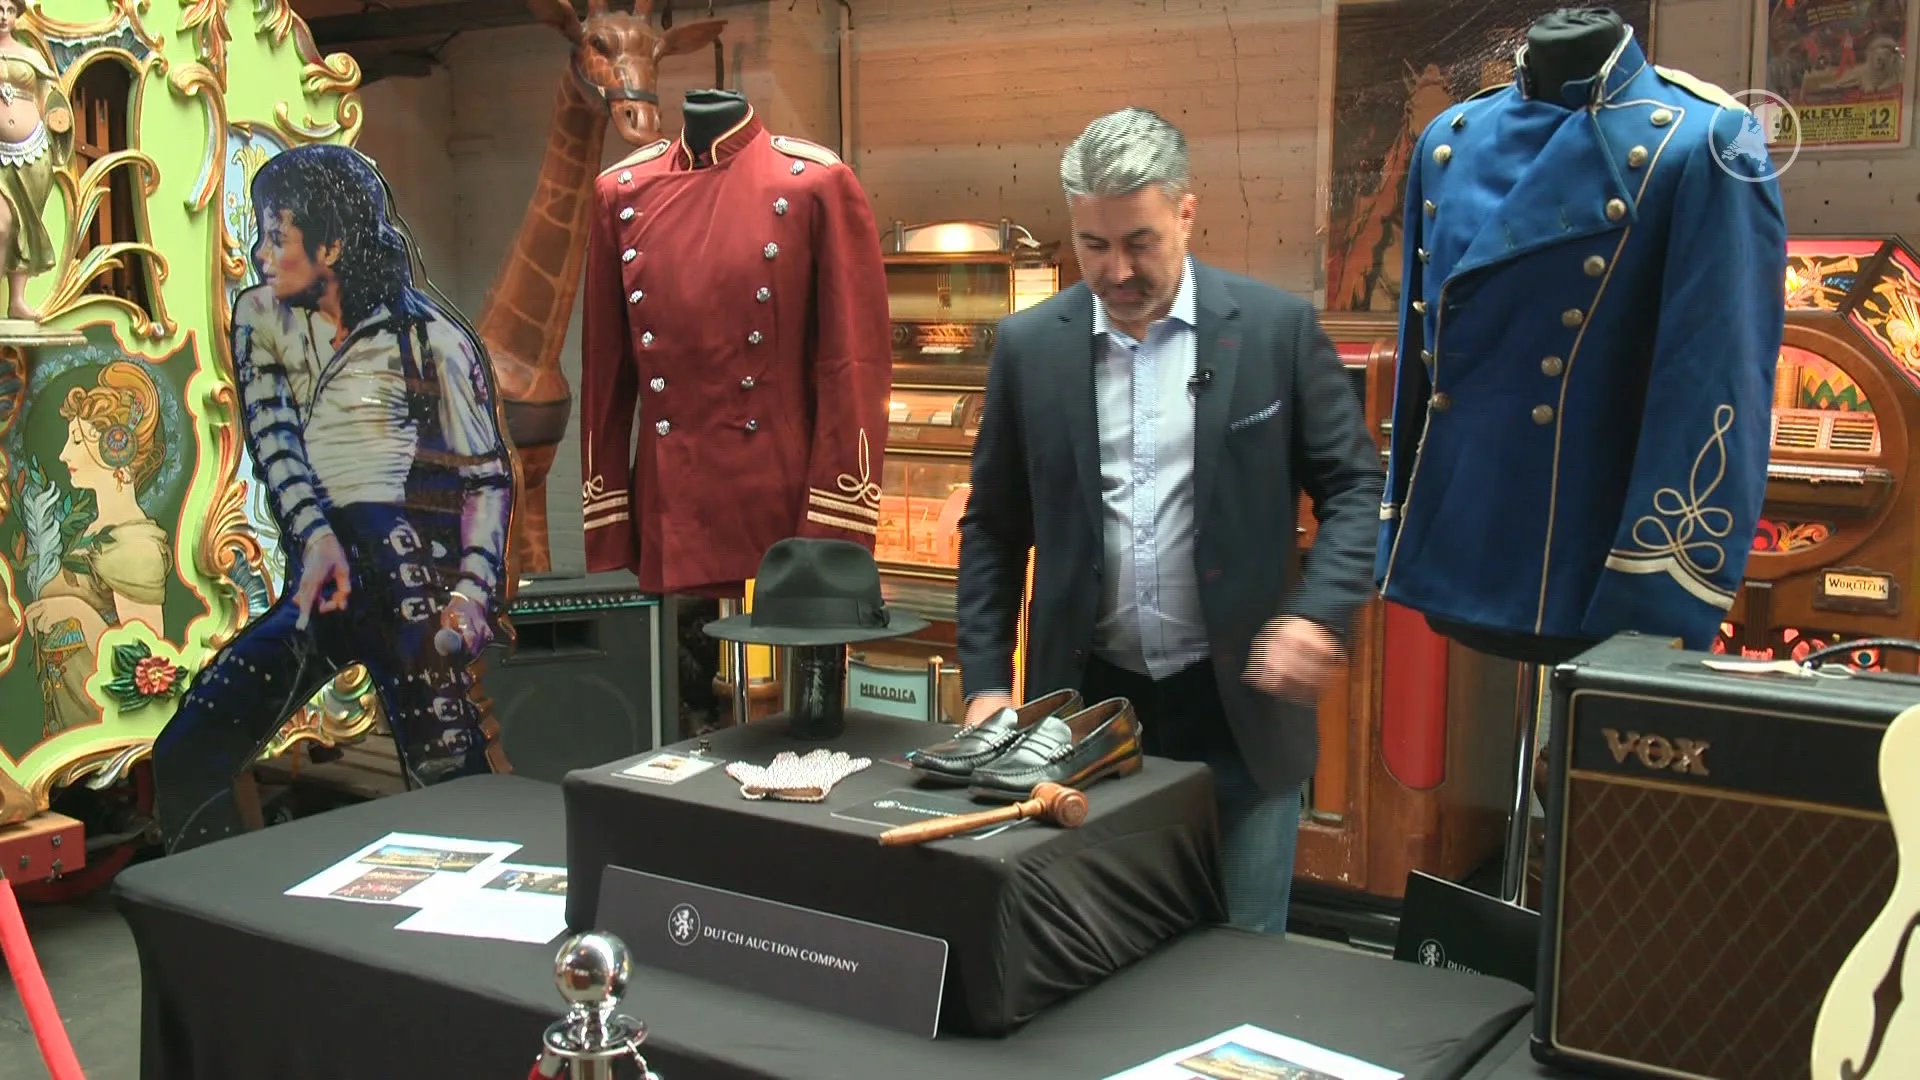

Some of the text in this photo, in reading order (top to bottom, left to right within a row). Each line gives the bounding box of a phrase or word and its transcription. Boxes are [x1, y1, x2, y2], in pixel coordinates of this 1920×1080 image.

[1800, 107, 1854, 120] KLEVE
[1869, 107, 1890, 129] 12
[860, 682, 917, 704] MELODICA
[1601, 727, 1711, 777] VOX
[703, 925, 860, 974] DUTCH AUCTION COMPANY
